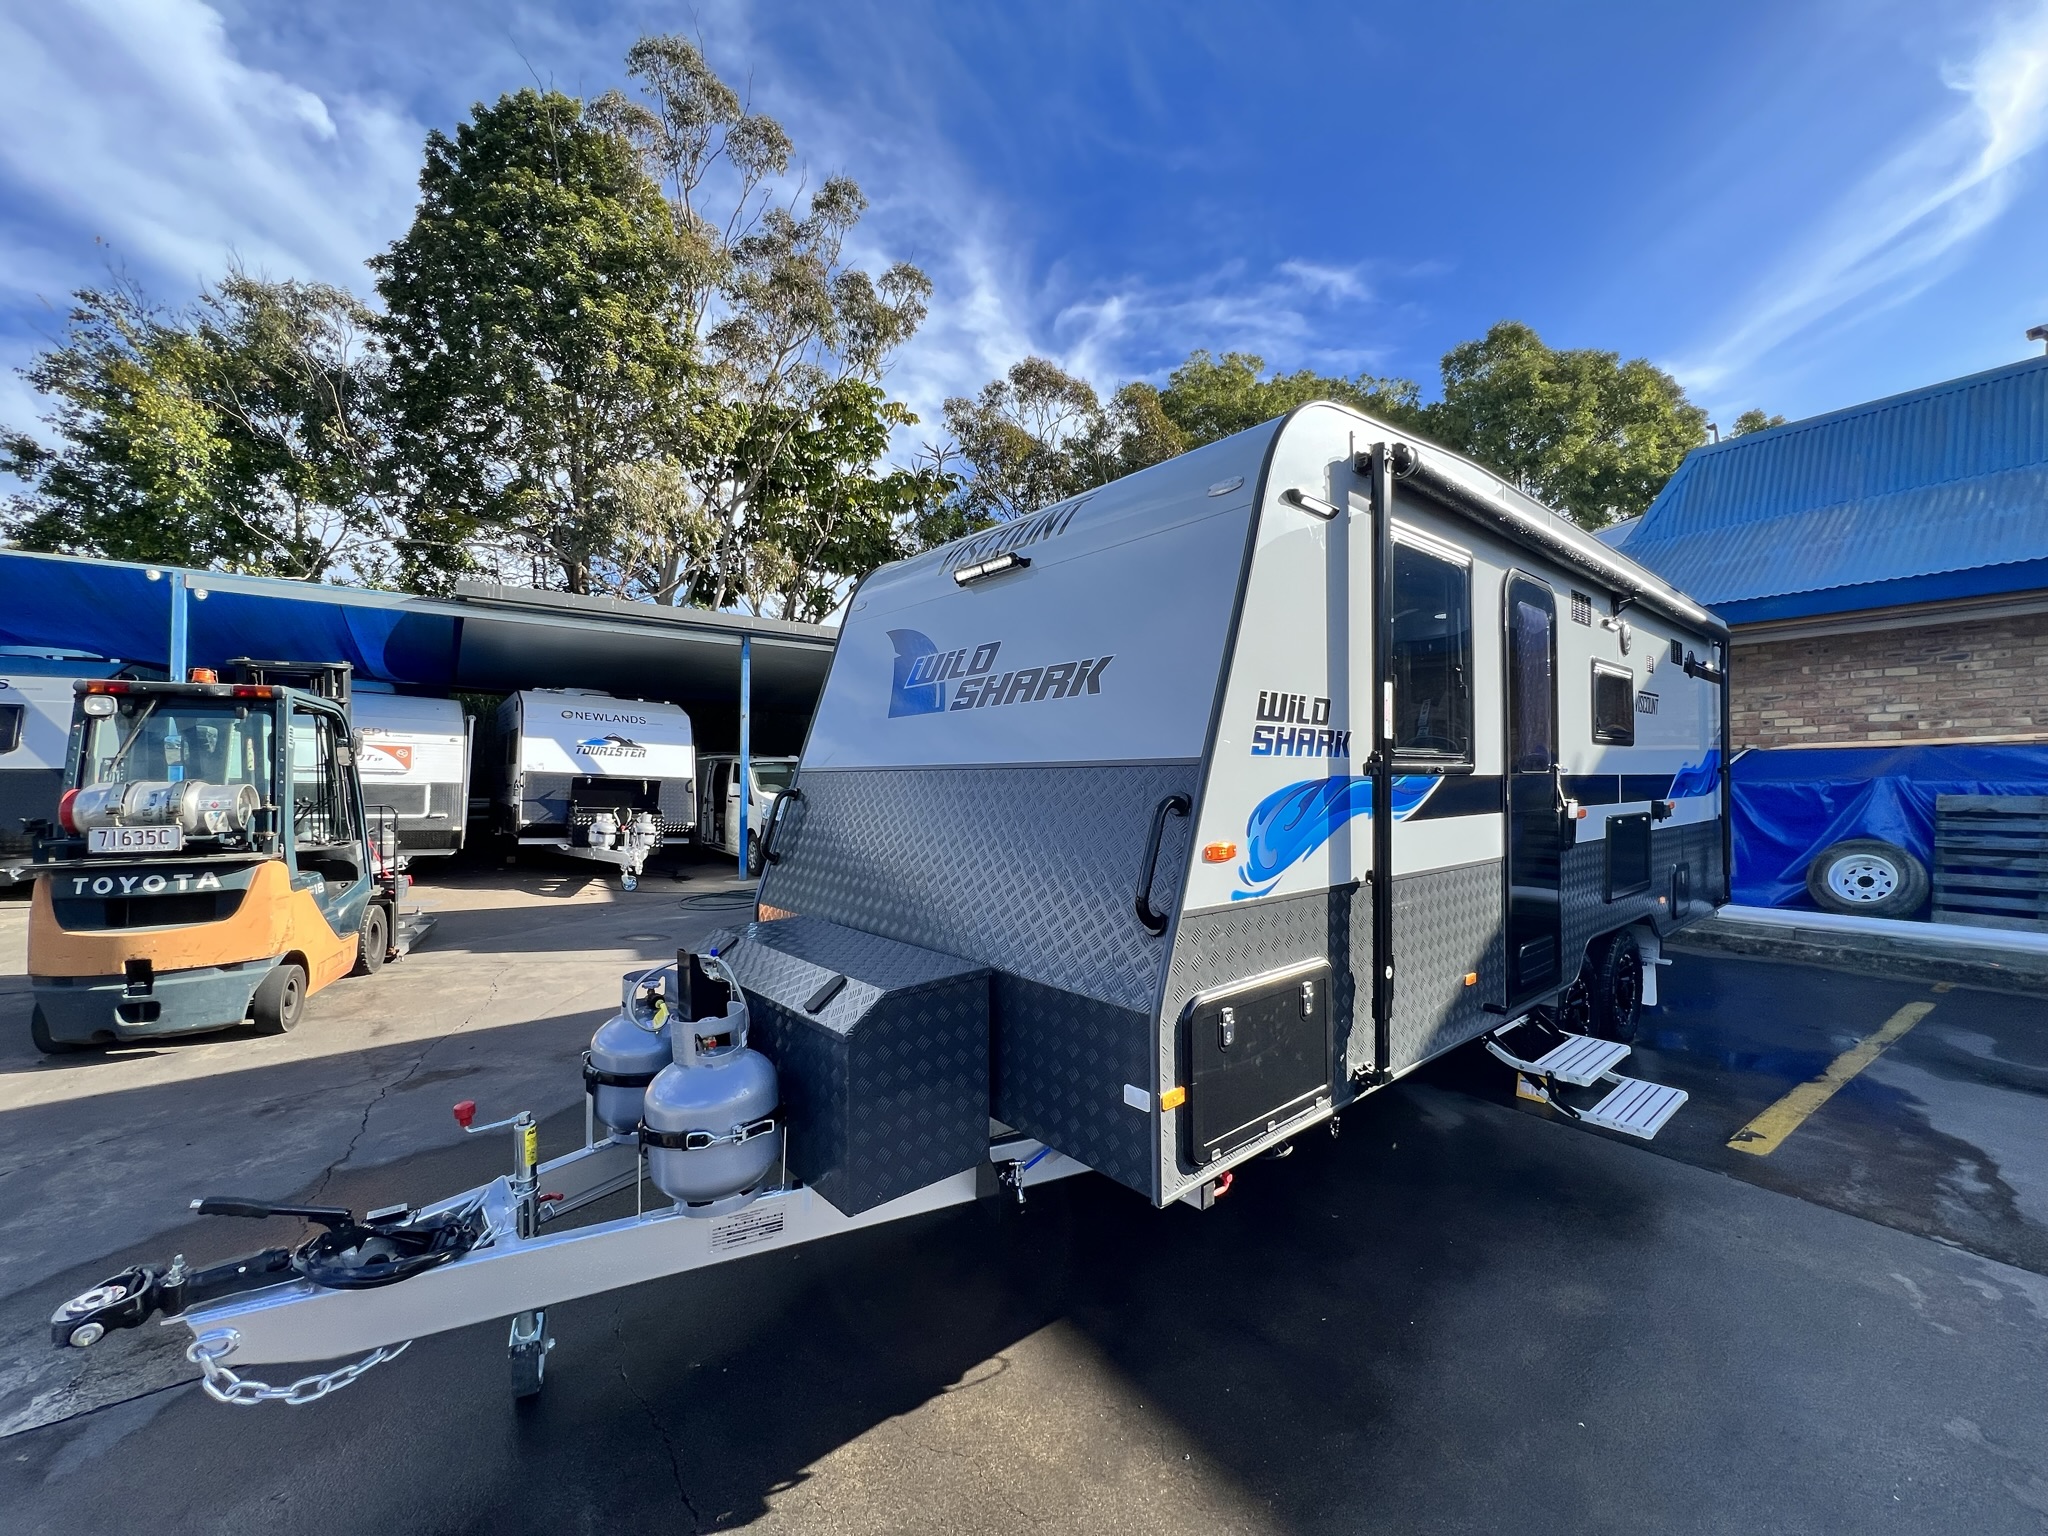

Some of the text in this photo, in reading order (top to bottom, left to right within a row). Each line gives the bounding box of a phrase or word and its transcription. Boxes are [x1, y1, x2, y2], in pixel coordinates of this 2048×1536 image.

[938, 496, 1095, 577] VISCOUNT
[904, 640, 1002, 689] WILD
[949, 654, 1116, 712] SHARK
[575, 711, 647, 725] NEWLANDS
[1255, 690, 1331, 726] WILD
[576, 745, 647, 758] TOURISTER
[1250, 724, 1352, 759] SHARK
[97, 829, 170, 848] 71635C
[72, 871, 222, 895] TOYOTA
